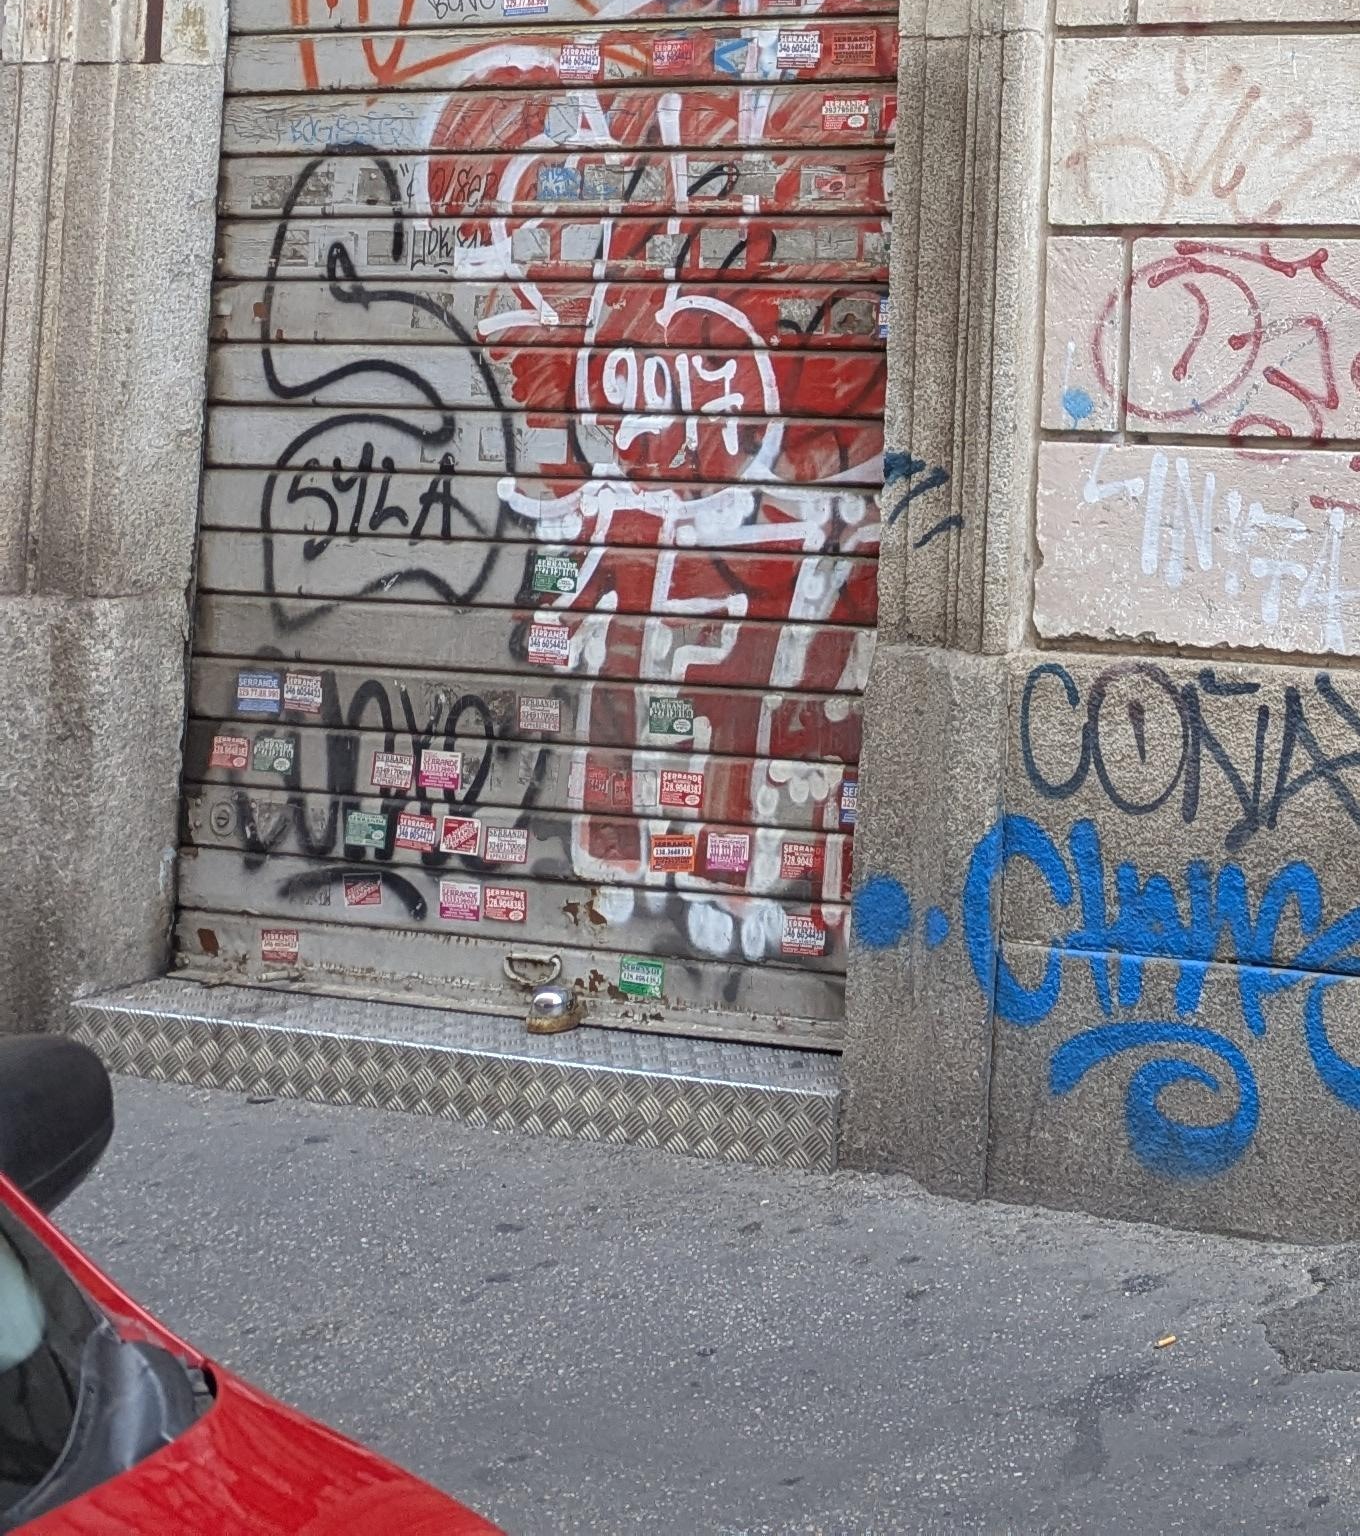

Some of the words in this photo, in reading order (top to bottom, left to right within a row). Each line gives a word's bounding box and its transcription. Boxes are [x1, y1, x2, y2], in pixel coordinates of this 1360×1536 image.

[780, 35, 818, 43] SERRANDE
[563, 48, 599, 56] SERRANDE
[531, 629, 568, 639] SERRANDE
[239, 678, 278, 688] SERRANDE
[662, 772, 702, 782] SERRANDE
[400, 818, 433, 828] SERRANDE
[489, 829, 526, 838] SERRANDE
